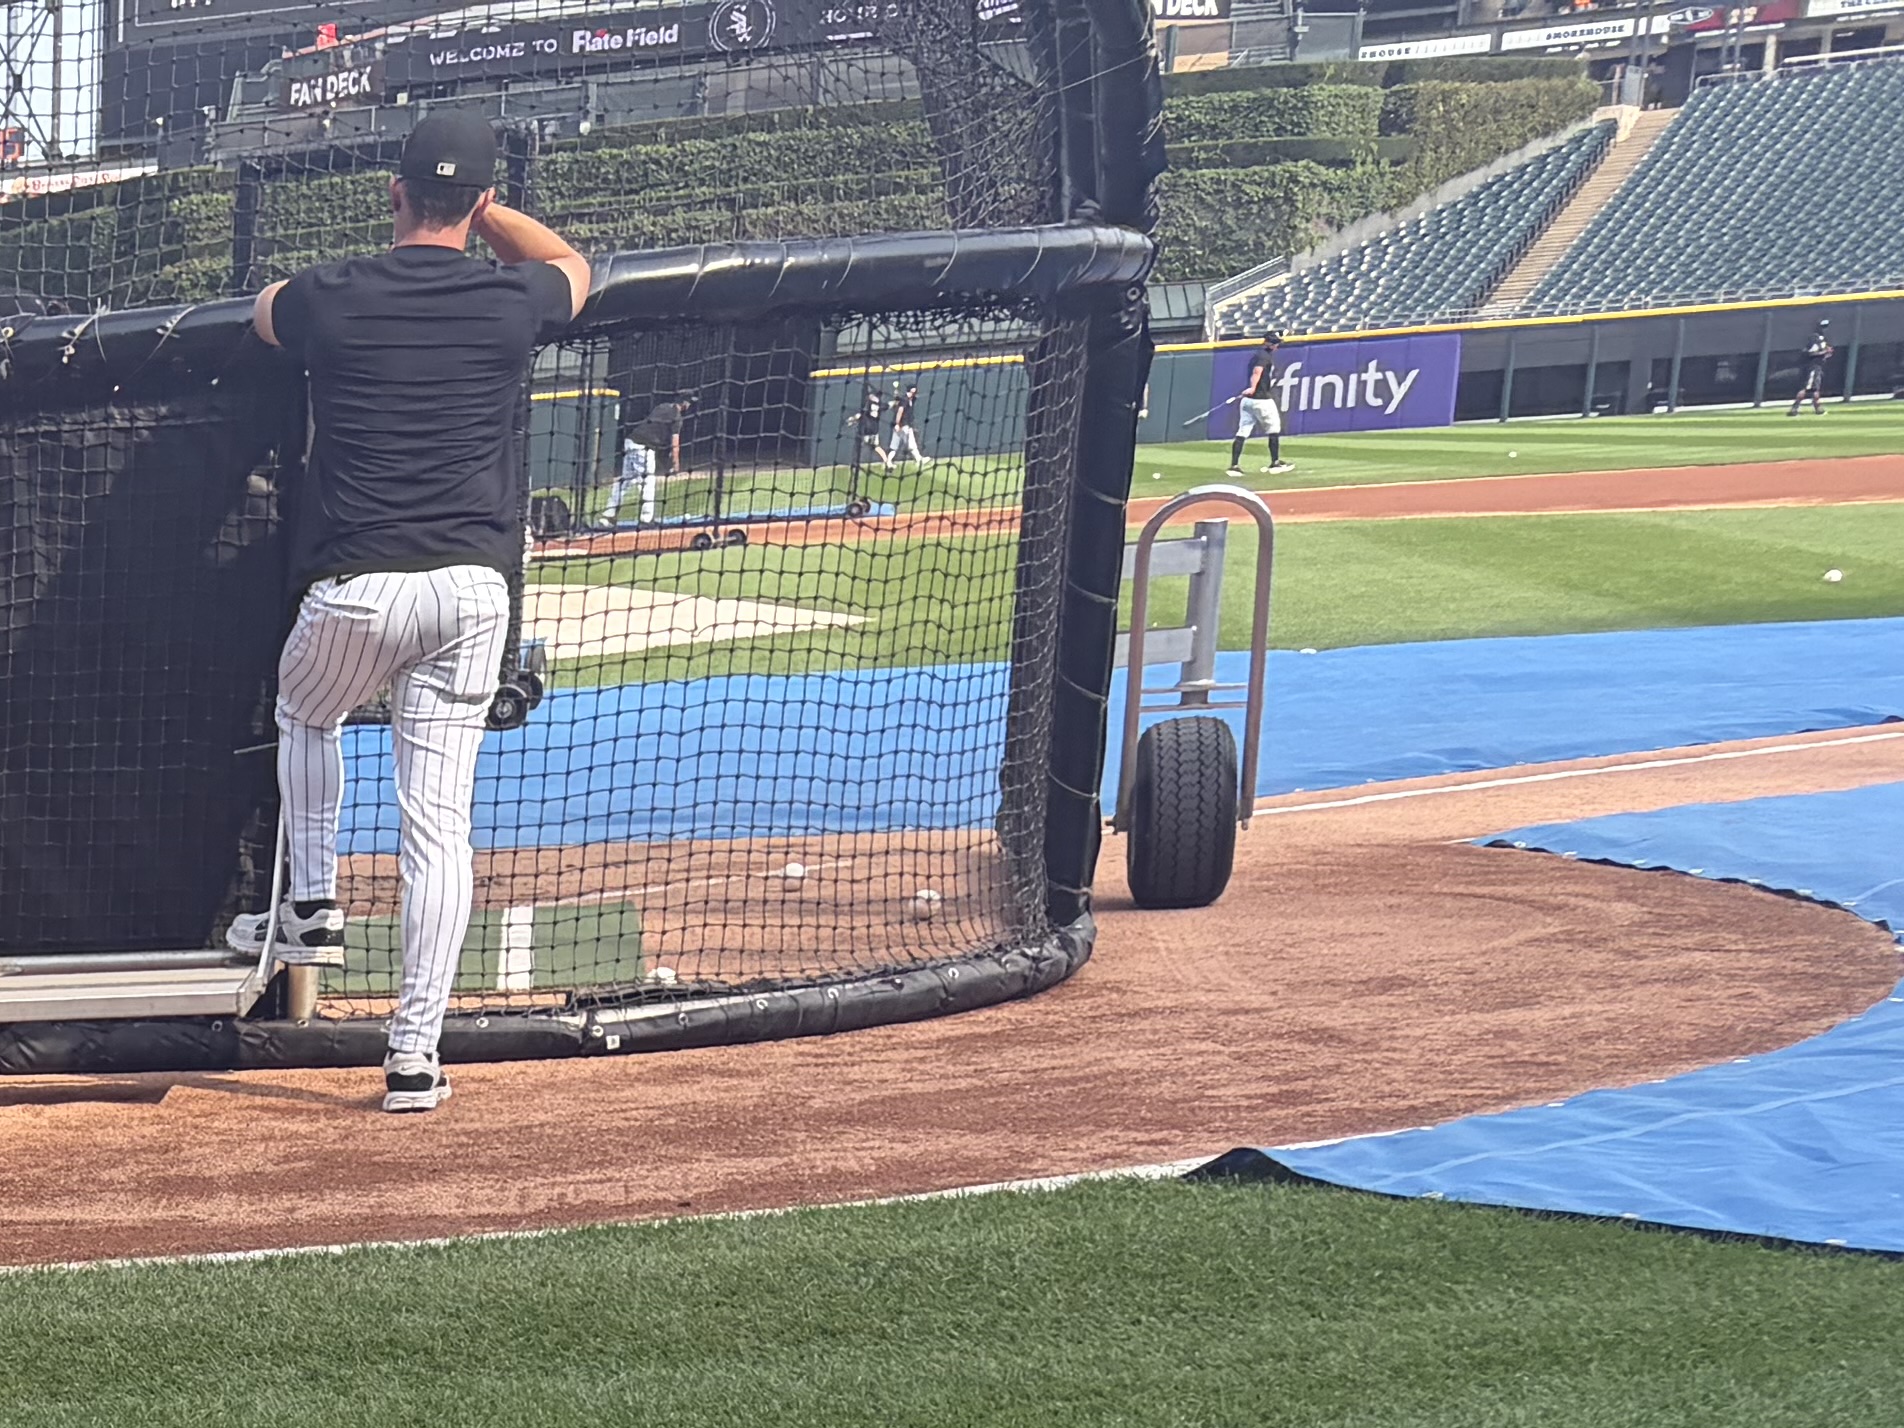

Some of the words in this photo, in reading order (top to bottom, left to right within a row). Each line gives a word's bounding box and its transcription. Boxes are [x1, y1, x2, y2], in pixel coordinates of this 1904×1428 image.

[429, 42, 525, 66] WELCOME
[532, 38, 558, 53] TO
[571, 28, 623, 53] Rate
[626, 24, 679, 48] Field
[290, 75, 323, 106] FAN
[325, 65, 372, 97] DECK
[1270, 359, 1420, 415] finity
